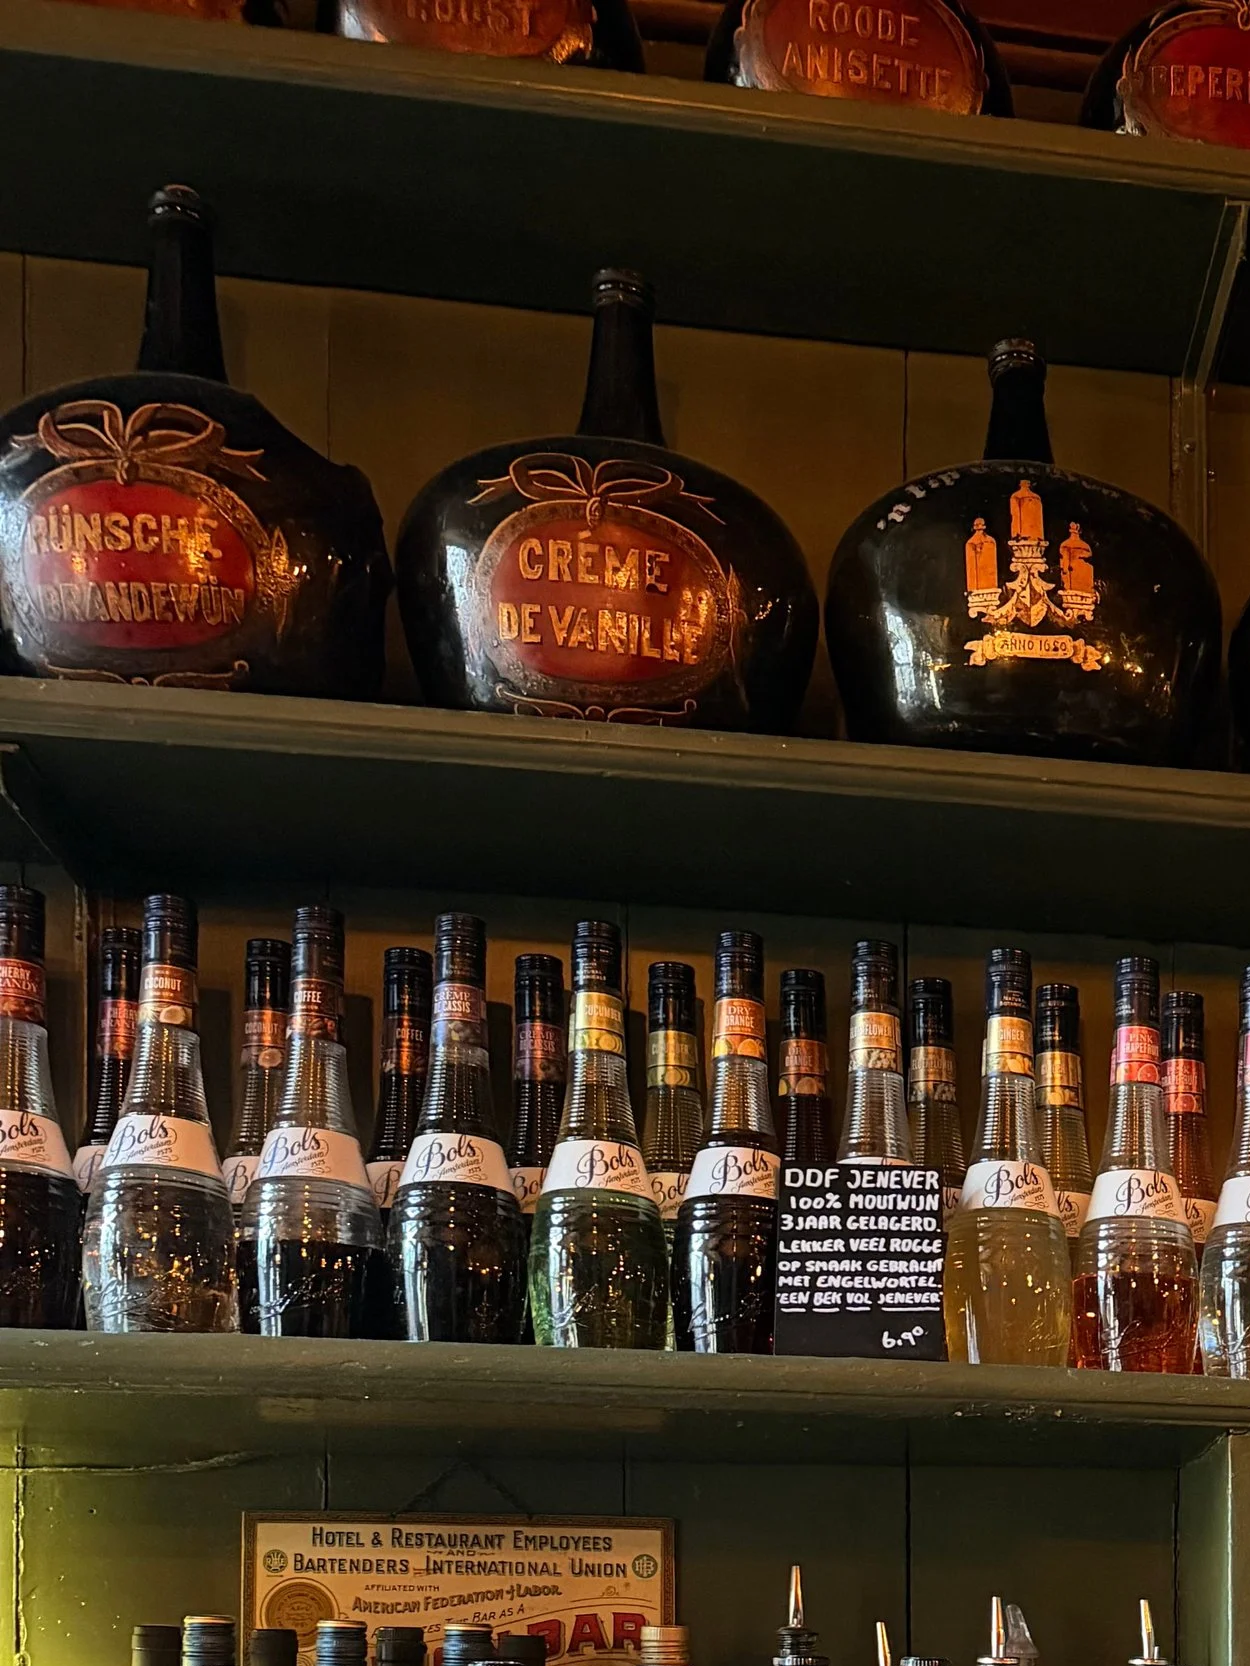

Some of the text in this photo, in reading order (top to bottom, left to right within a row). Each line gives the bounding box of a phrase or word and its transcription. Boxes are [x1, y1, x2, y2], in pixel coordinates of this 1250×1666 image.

[810, 0, 921, 46] ROODE
[782, 42, 952, 99] ANISETTE
[499, 602, 702, 665] DE VANILLE
[144, 977, 183, 992] COCONUT
[294, 990, 323, 1004] COFFEE
[443, 1001, 472, 1014] CASSIS
[727, 1004, 751, 1016] DRY
[724, 1013, 755, 1029] ORANGE
[396, 1027, 424, 1042] COFFEE
[999, 1029, 1025, 1043] GINGER
[1128, 1032, 1154, 1044] PINK
[104, 1116, 170, 1163] Bols
[261, 1128, 322, 1175] Bols
[412, 1135, 477, 1181] Bols
[575, 1145, 636, 1187] Bols
[709, 1149, 770, 1193] Bols
[785, 1167, 939, 1190] DDF JENEVER
[983, 1163, 1041, 1207] Bols
[790, 1193, 940, 1211] 100% MOUTWIJN
[1114, 1172, 1169, 1216] Bols
[846, 1215, 942, 1232] GELAGERD.
[779, 1237, 943, 1254] LEKKER VEEL ROGGE
[778, 1258, 944, 1273] OP SMAAK GEBRACHT
[778, 1275, 942, 1289] MET ENGELWORTEL.
[813, 1292, 872, 1306] BEK VOL
[371, 1531, 383, 1548] &
[364, 1584, 416, 1592] AFFILIATED
[472, 1611, 497, 1622] BAR
[500, 1608, 514, 1616] AS
[517, 1604, 525, 1614] A
